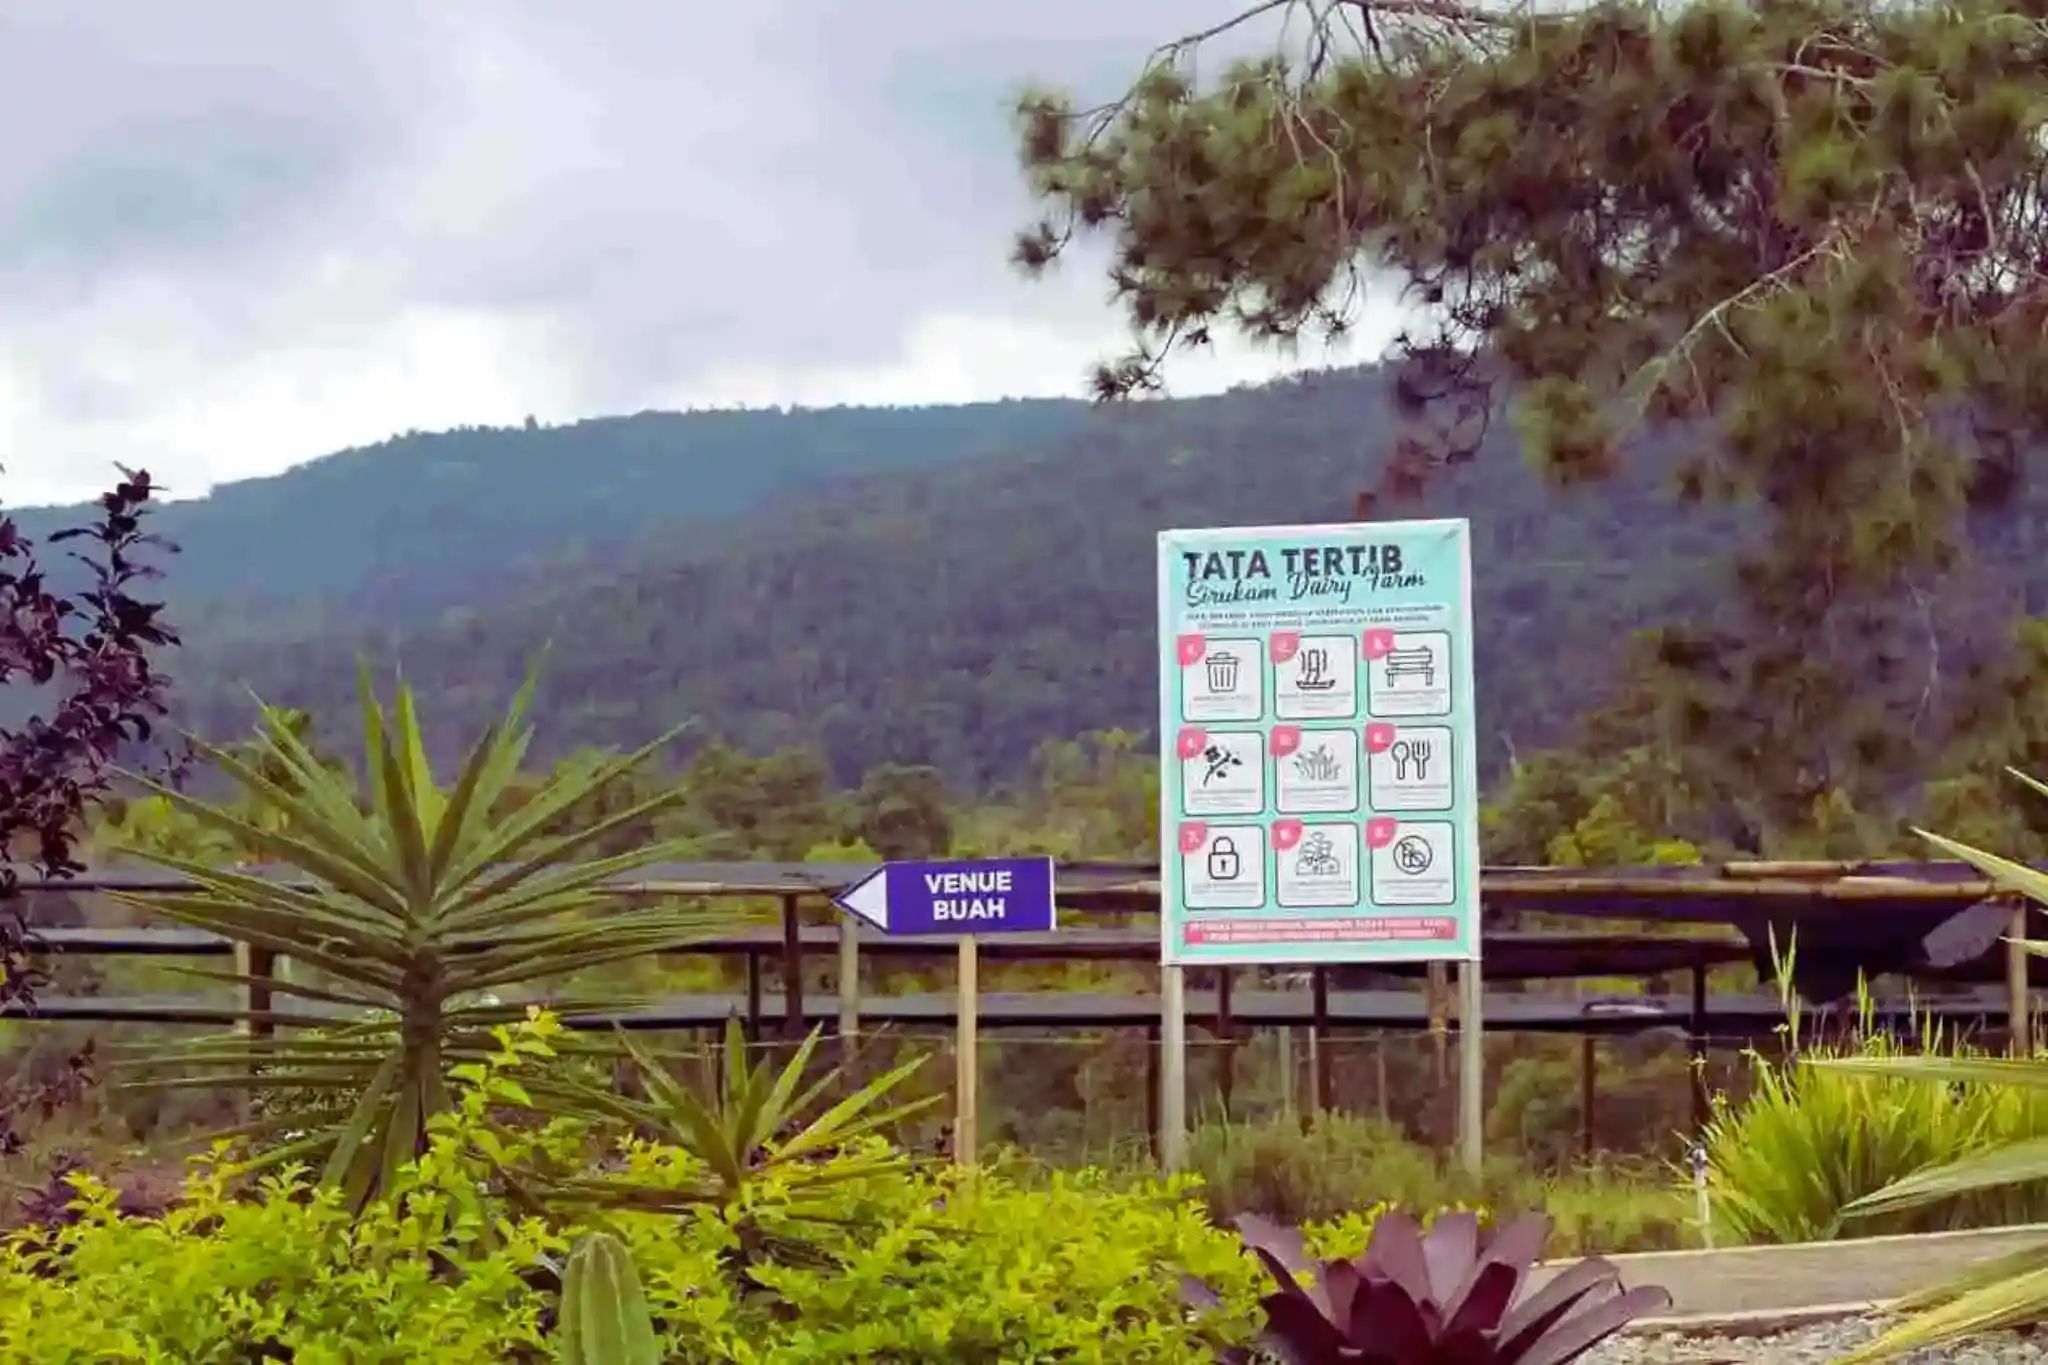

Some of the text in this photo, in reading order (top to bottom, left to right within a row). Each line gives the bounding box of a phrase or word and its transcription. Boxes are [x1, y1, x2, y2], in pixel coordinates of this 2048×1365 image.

[1183, 544, 1403, 581] TATA TERTIB
[1185, 564, 1428, 607] Sirukam Dairy Farm
[924, 871, 1012, 894] VENUE
[933, 898, 1005, 921] BUAH
